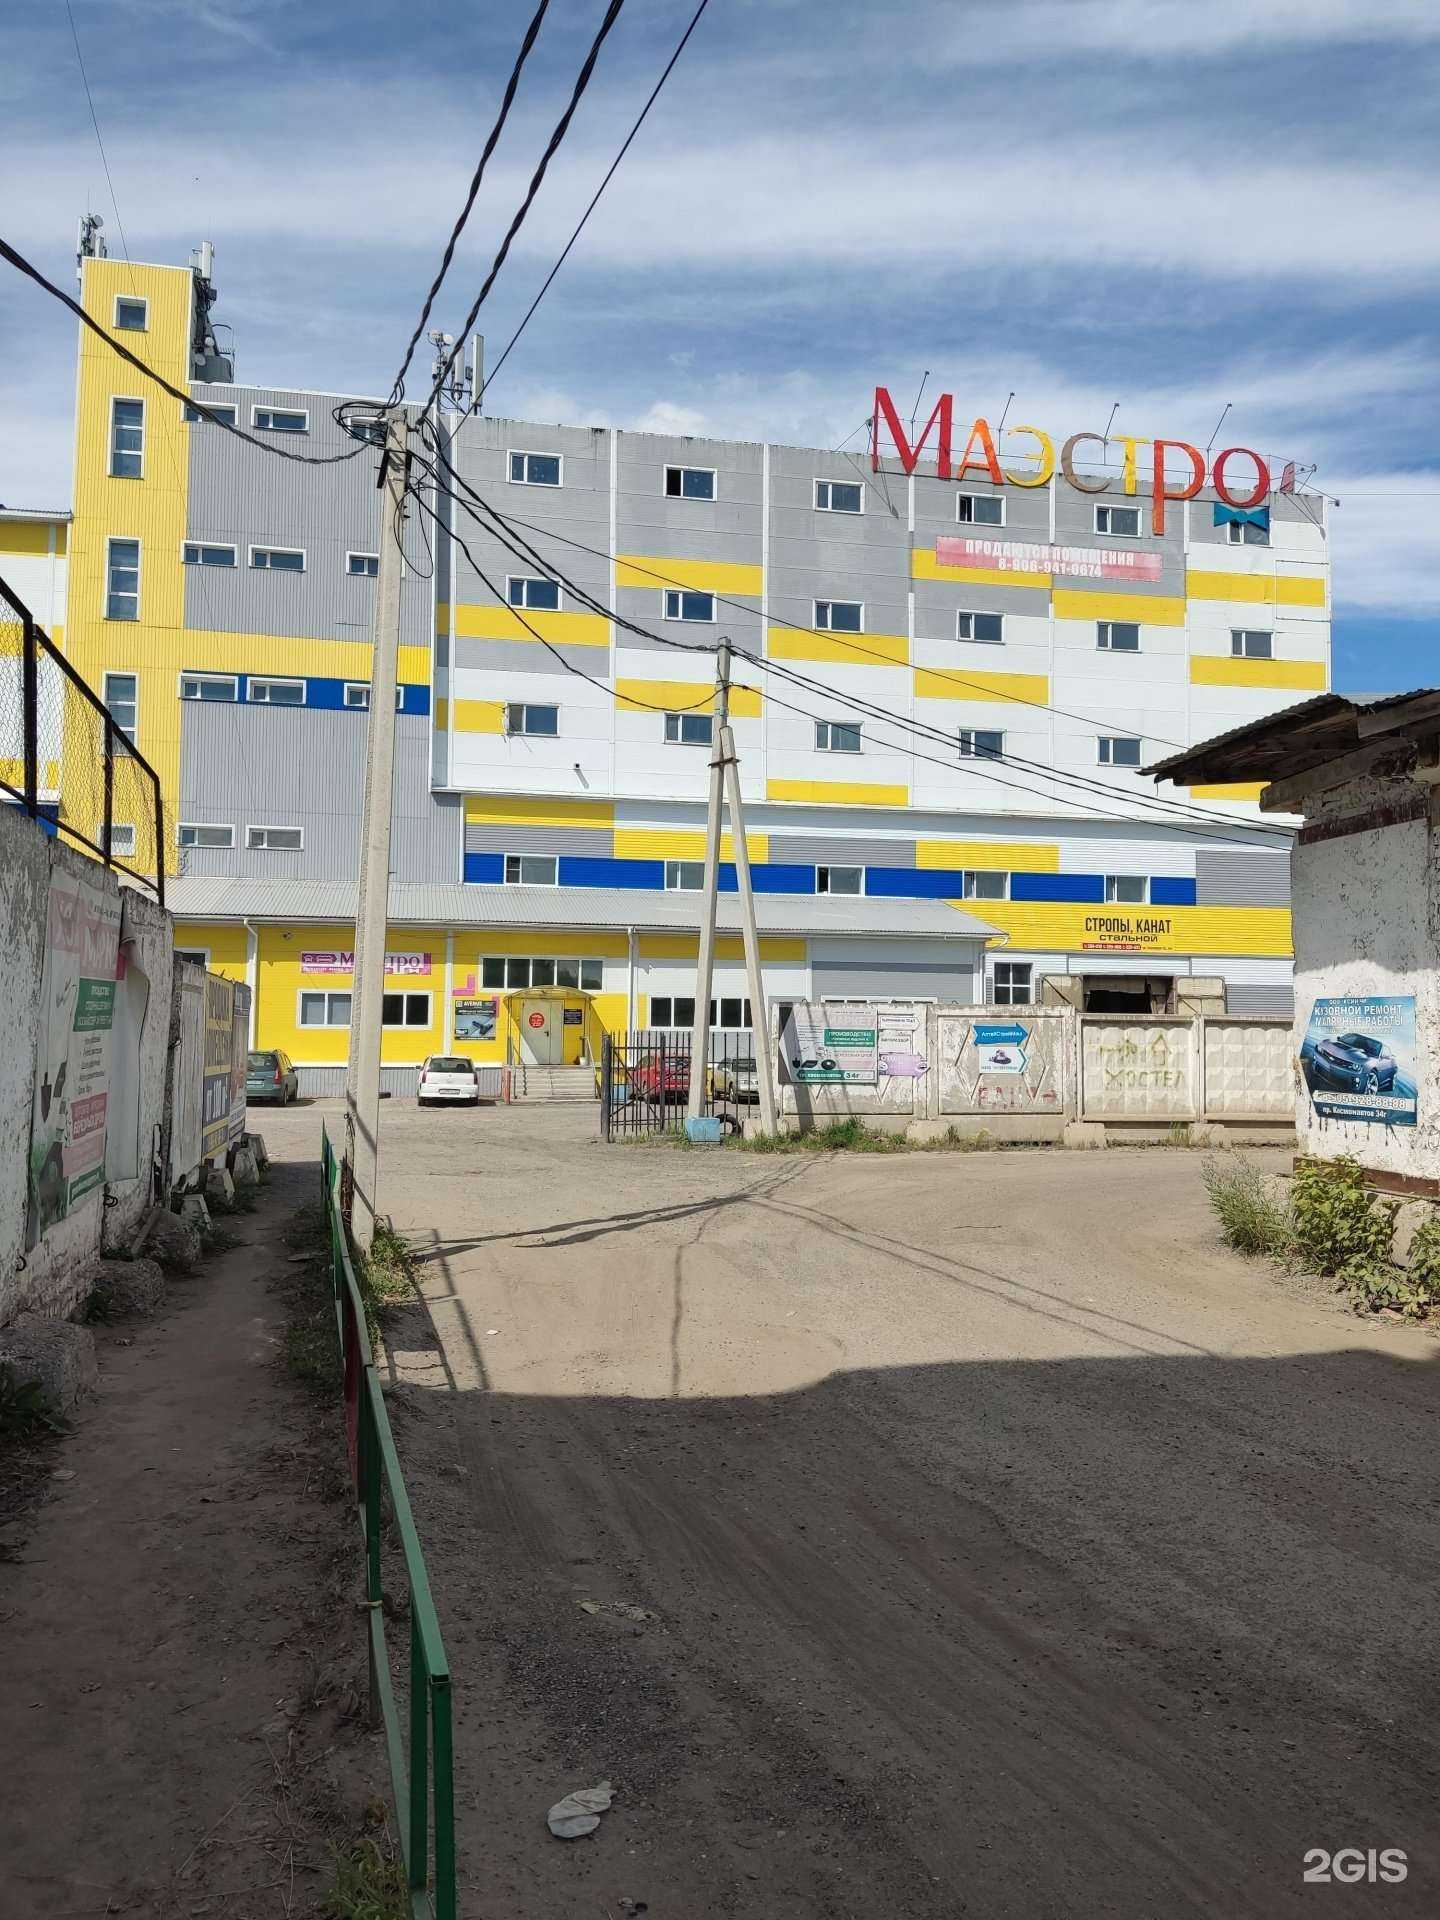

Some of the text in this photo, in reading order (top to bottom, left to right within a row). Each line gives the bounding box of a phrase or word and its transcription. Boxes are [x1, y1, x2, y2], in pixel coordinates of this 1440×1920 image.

[1053, 546, 1135, 566] ПОМЕЩЕНИЯ
[1085, 917, 1172, 934] СТРОПЫ, КАНАТ
[1364, 1004, 1403, 1015] РЕМОНТ
[1366, 1016, 1404, 1026] РАБОТЫ
